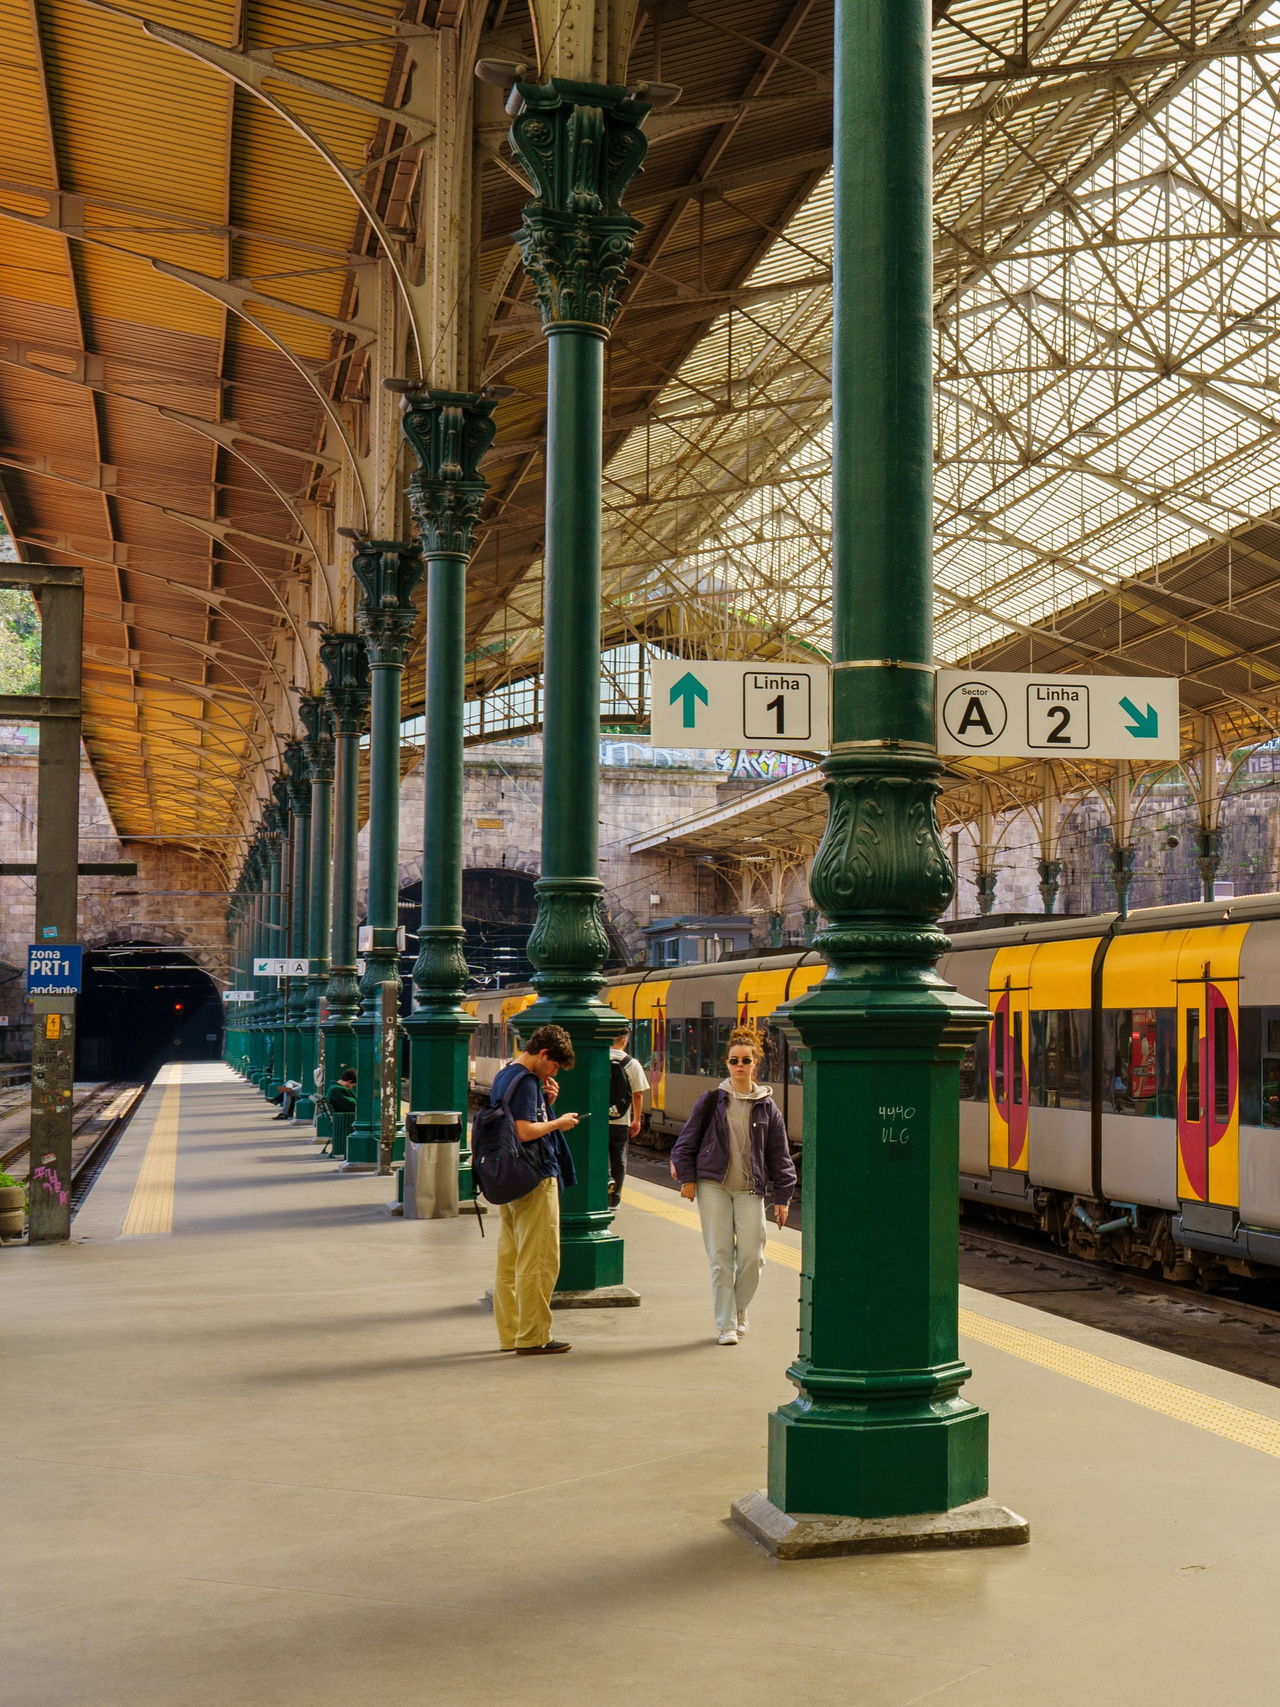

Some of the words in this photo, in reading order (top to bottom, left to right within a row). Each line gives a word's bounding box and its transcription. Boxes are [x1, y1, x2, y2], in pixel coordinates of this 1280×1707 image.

[753, 675, 801, 691] Linha
[961, 687, 989, 696] Sector
[1036, 687, 1080, 702] Linha
[766, 694, 785, 735] 1
[956, 696, 994, 735] A
[1046, 705, 1072, 744] 2
[30, 950, 61, 959] zona
[30, 960, 70, 976] PRT1
[295, 963, 304, 972] A
[29, 984, 78, 994] andante
